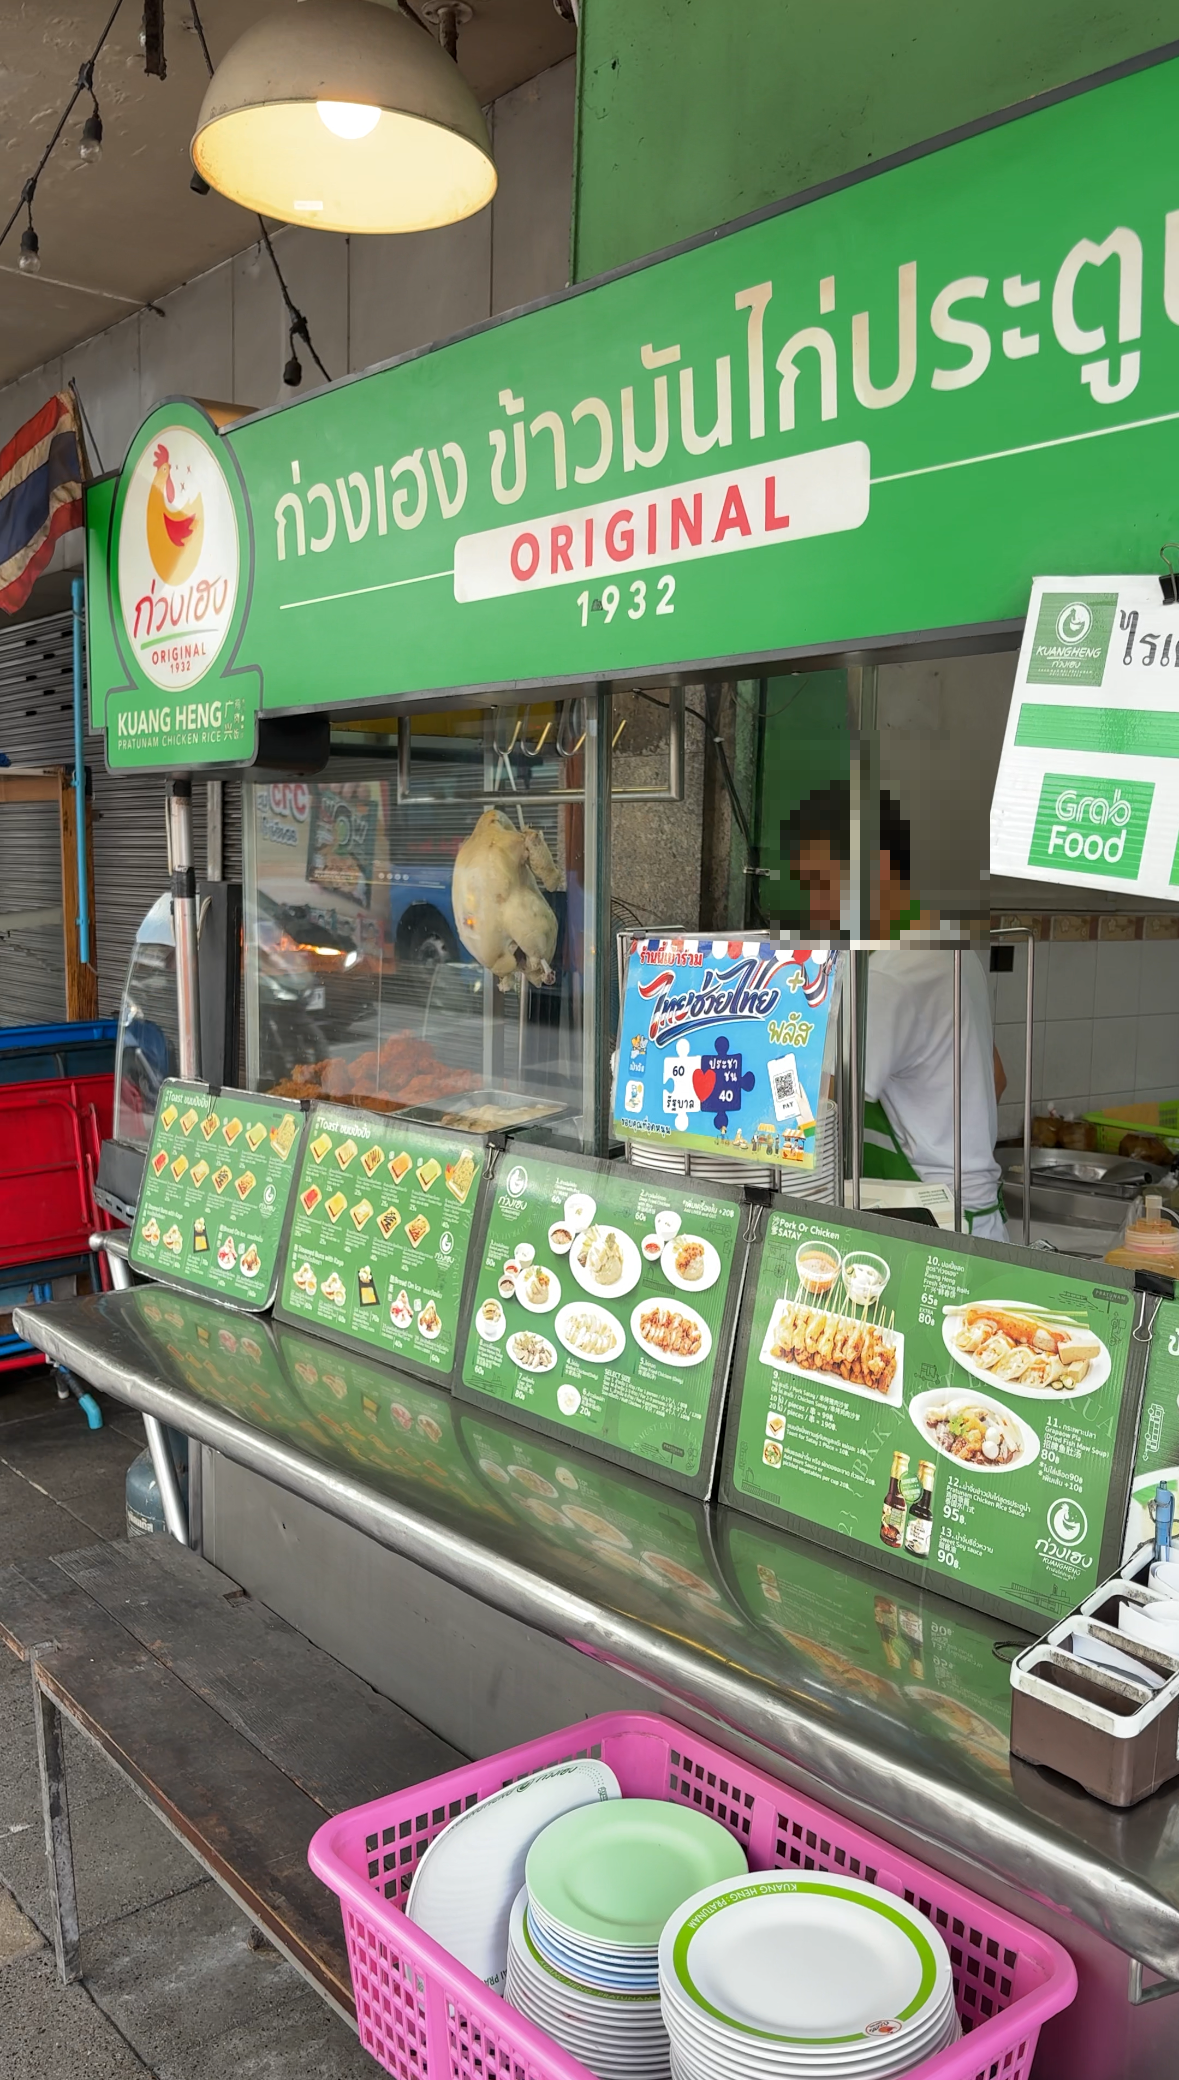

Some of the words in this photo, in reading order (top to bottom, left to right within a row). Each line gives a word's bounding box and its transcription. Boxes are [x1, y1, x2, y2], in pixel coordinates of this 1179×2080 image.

[274, 441, 469, 562] ก่วงเฮง
[510, 475, 790, 582] ORIGINAL
[133, 575, 228, 638] ก่วงเฮง
[577, 574, 676, 627] 1932
[152, 642, 207, 665] ORIGINAL
[1036, 645, 1102, 658] KUANGHENG
[170, 660, 191, 674] 1932
[117, 706, 171, 737] KUANG
[175, 700, 222, 731] HENG
[117, 735, 159, 750] PRATUNAM
[161, 732, 198, 747] CHICKEN
[202, 730, 221, 743] RICE
[1055, 789, 1131, 827] Grab
[1047, 824, 1127, 864] Food
[638, 957, 781, 1040] ไทยช่วยไทย
[768, 1012, 814, 1047] พลัส
[672, 1066, 685, 1077] 60
[709, 1058, 738, 1070] ประชา
[724, 1071, 738, 1082] ชน
[719, 1090, 734, 1102] 40
[782, 1101, 795, 1110] PAY
[319, 1116, 339, 1132] Toast
[778, 1228, 802, 1240] SATAY
[780, 1218, 796, 1230] Pork
[798, 1222, 808, 1232] Or
[810, 1225, 839, 1240] Chicken
[927, 1255, 940, 1267] 10.
[773, 1370, 780, 1380] 9.
[769, 1402, 777, 1410] 20
[787, 1408, 804, 1420] pieces
[770, 1394, 777, 1402] 10
[788, 1401, 805, 1412] pieces
[1046, 1416, 1061, 1428] 11.
[1044, 1433, 1063, 1443] (Dried
[1063, 1438, 1075, 1447] Fish
[1077, 1443, 1090, 1452] Maw
[1091, 1447, 1110, 1458] Soup)
[946, 1484, 973, 1499] Pratunam
[973, 1494, 995, 1507] Chicken
[995, 1502, 1007, 1511] Rice
[1008, 1508, 1025, 1518] Sauce
[939, 1535, 955, 1546] Sweet
[956, 1541, 966, 1551] Soy
[967, 1546, 983, 1556] sauce
[1035, 1537, 1093, 1568] ก่วงเฮง
[1042, 1557, 1081, 1576] KUANGHENG
[730, 1887, 758, 1901] HENG
[759, 1883, 797, 1894] KUANG
[688, 1899, 727, 1929] PRATUNAM
[540, 1961, 568, 1982] KUANG
[566, 1980, 593, 1993] HENG
[598, 1992, 653, 2001] PRATUNAM
